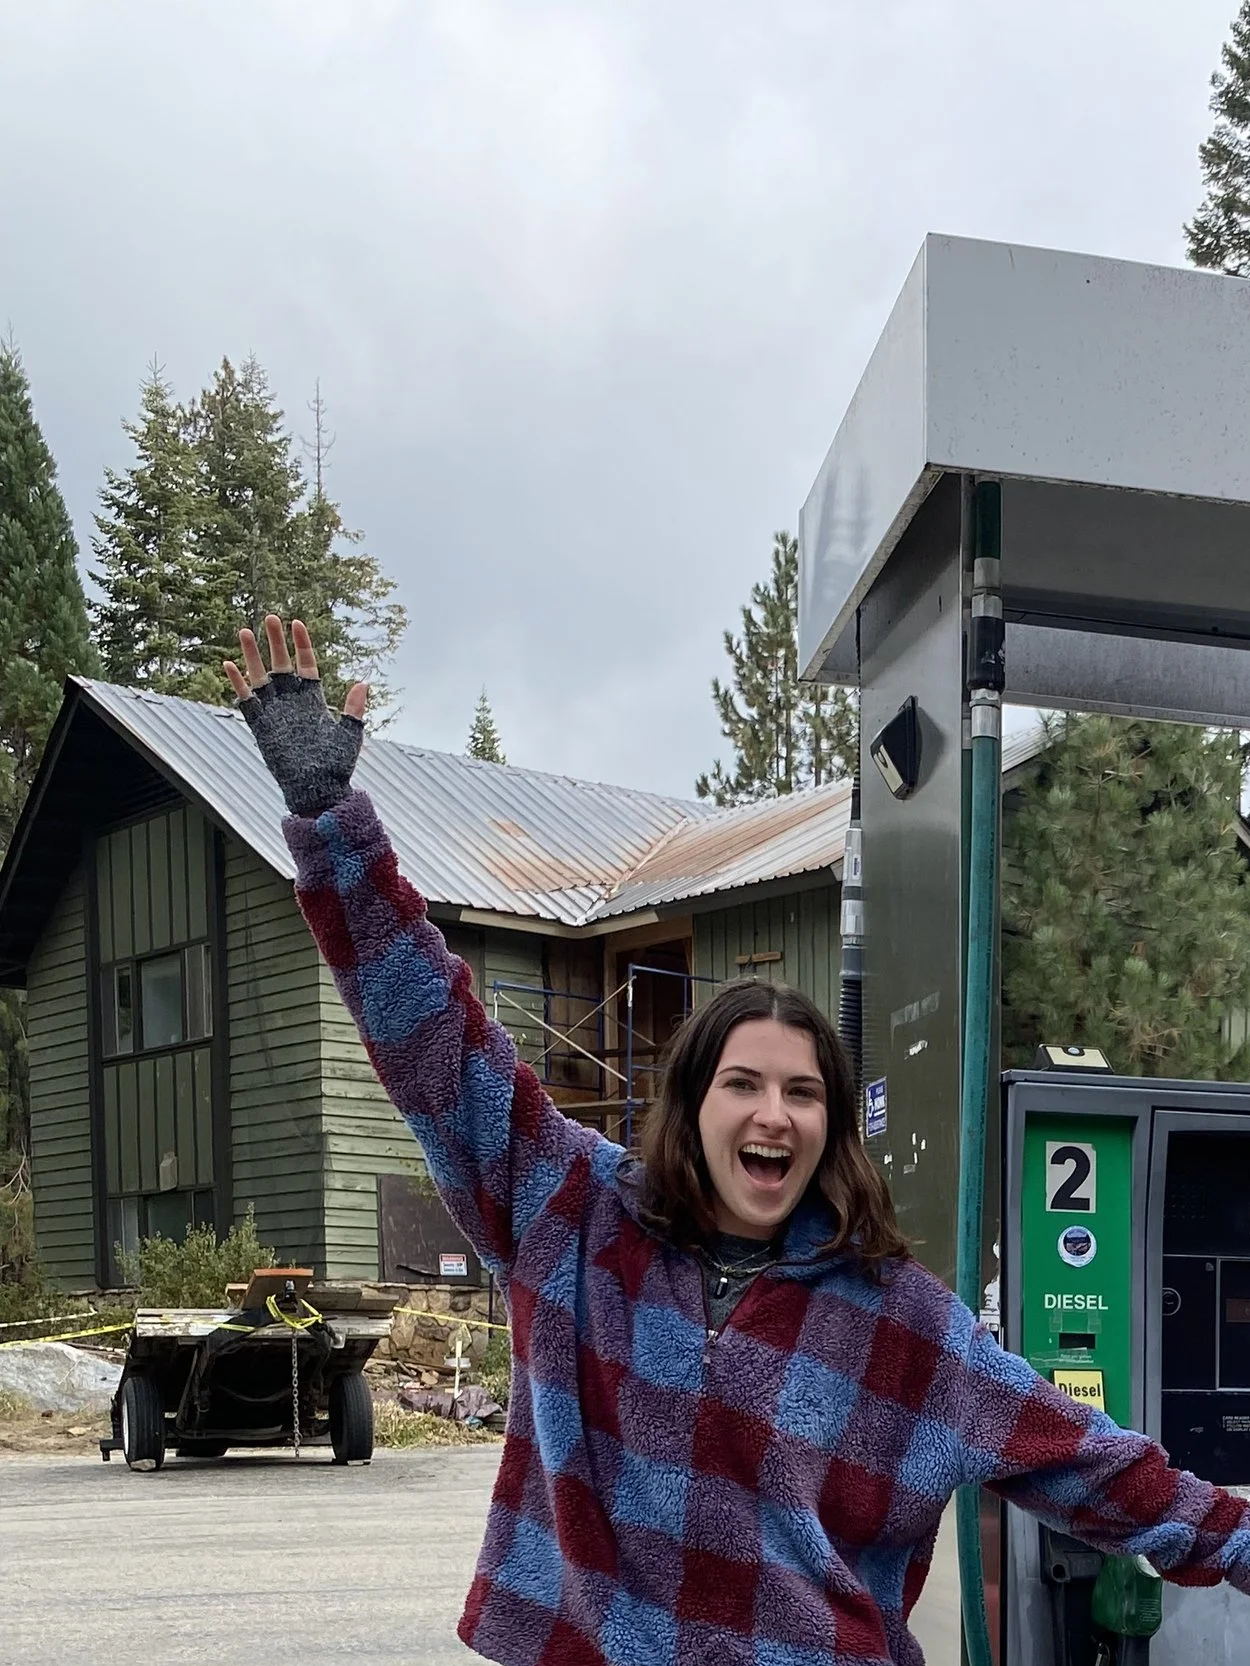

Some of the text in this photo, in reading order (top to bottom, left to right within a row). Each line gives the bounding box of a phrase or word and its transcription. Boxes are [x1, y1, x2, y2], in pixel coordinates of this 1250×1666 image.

[1050, 1146, 1091, 1210] 2
[1044, 1294, 1108, 1310] DIESEL
[1059, 1383, 1101, 1397] Diesel
